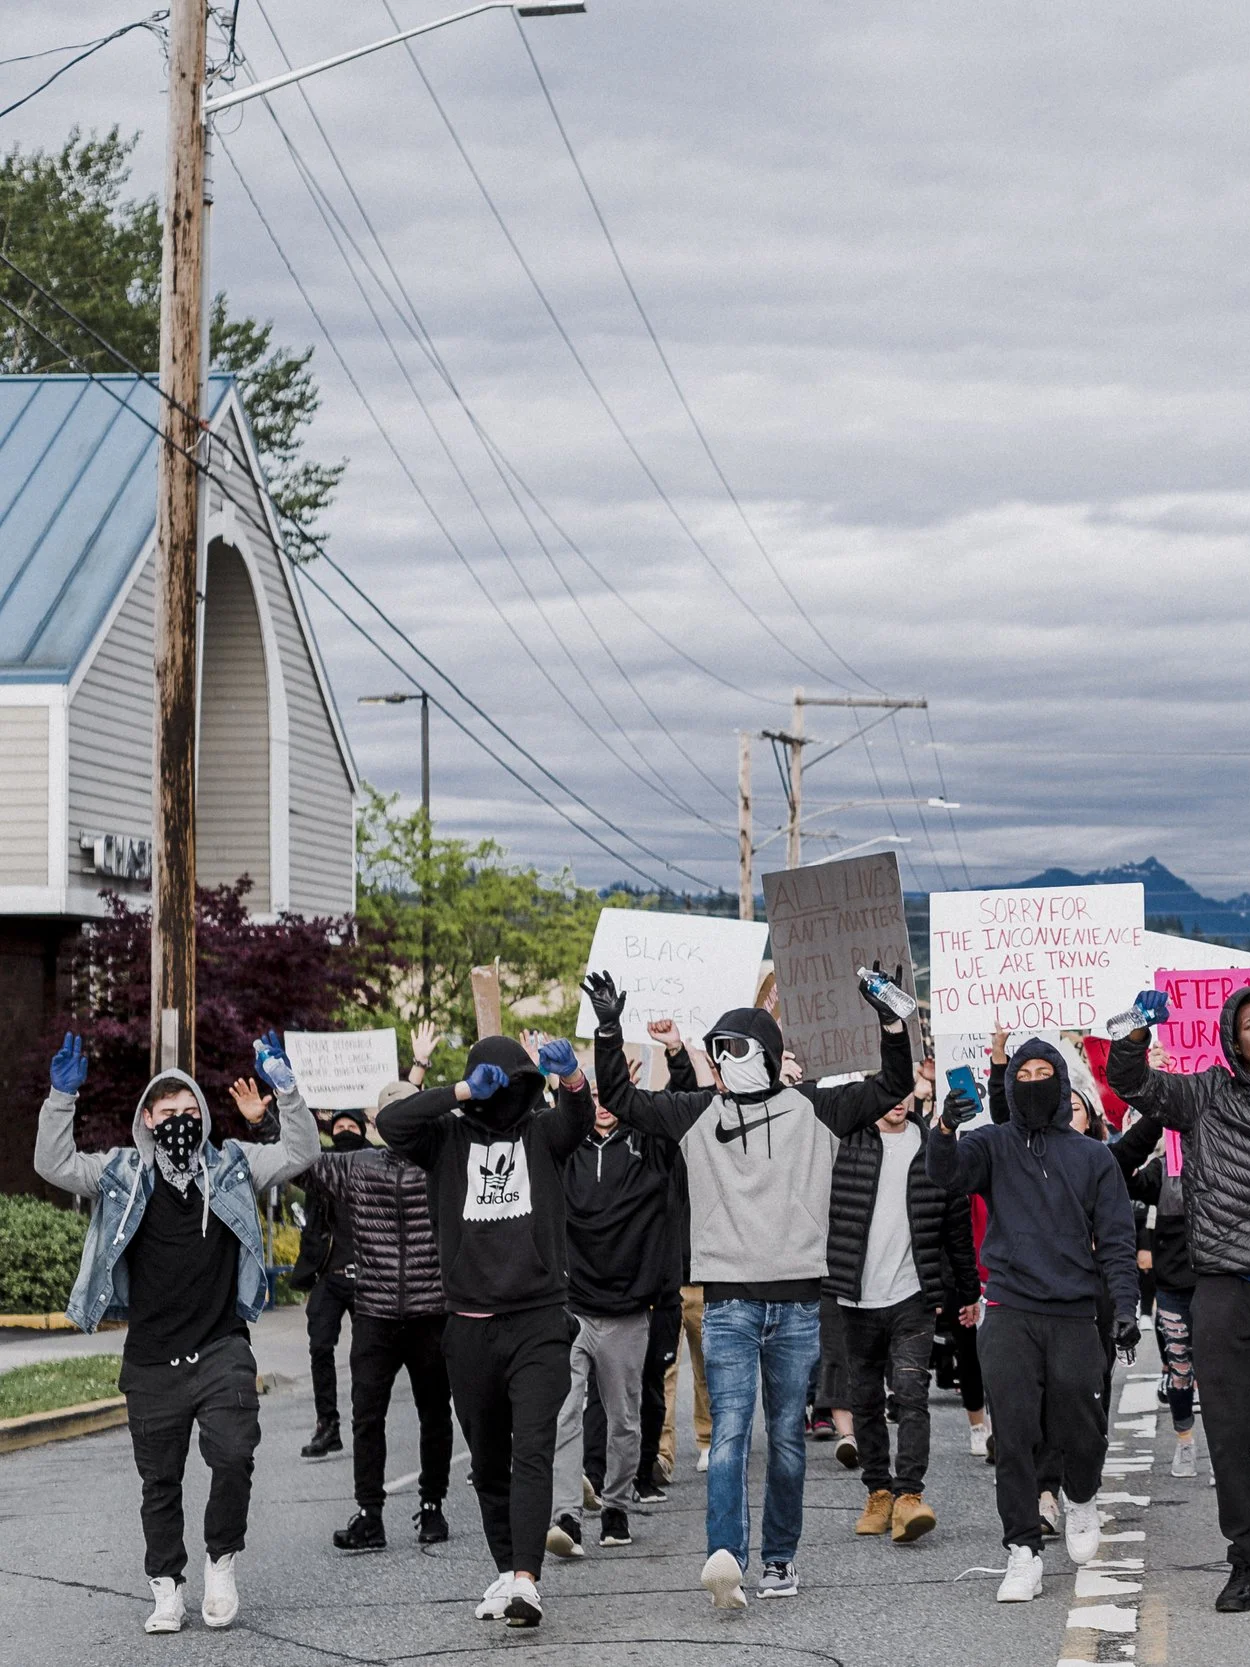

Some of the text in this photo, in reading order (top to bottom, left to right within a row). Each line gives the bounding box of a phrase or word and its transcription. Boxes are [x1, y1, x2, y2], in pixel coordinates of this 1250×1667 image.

[771, 865, 900, 916] ALL LIVES
[977, 897, 1093, 924] SORRY FOR
[771, 904, 902, 950] CAN'T MATTER
[933, 926, 1144, 953] THE INCONVENIENCE
[625, 935, 704, 963] BLACK
[777, 953, 847, 988] UNTIL
[955, 951, 1111, 979] WE ARE TRYING
[619, 975, 686, 995] LIVES
[932, 987, 960, 1014] TO
[967, 978, 1049, 1006] CHANGE
[1056, 976, 1096, 999] THE
[1164, 977, 1234, 1009] AFTER
[620, 1006, 708, 1029] ATTER
[784, 988, 839, 1026] LIVES
[995, 1001, 1097, 1031] WORLD
[476, 1191, 520, 1205] adidas
